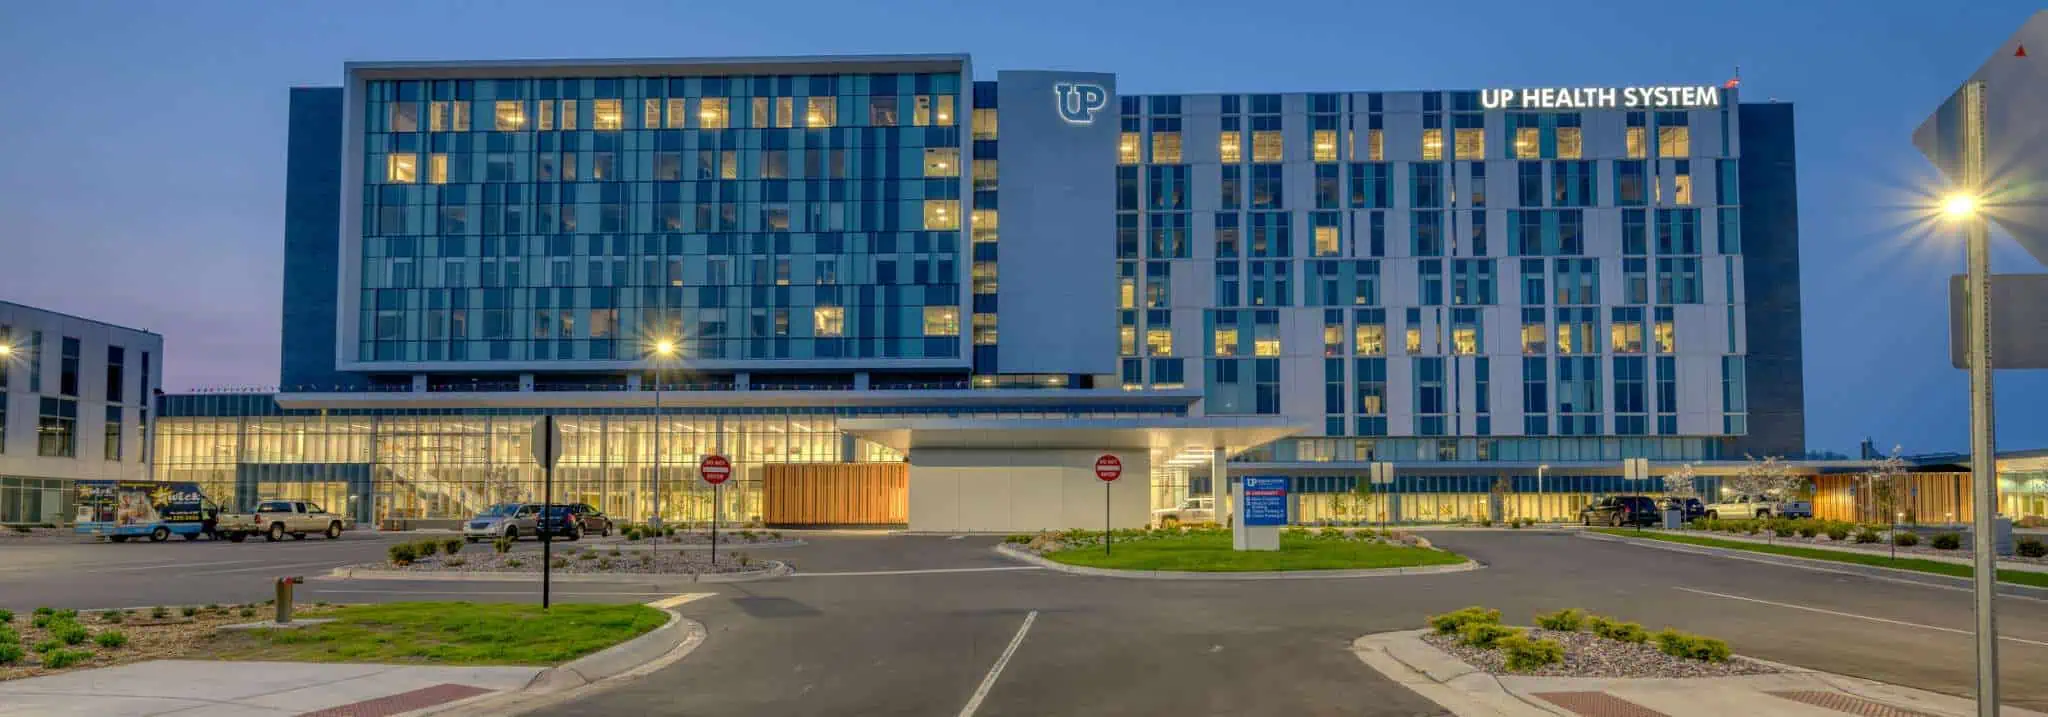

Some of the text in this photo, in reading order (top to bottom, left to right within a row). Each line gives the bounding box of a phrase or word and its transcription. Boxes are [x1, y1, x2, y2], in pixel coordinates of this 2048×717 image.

[1056, 84, 1106, 123] UP
[1481, 86, 1719, 108] UP HEALTH SYSTEM
